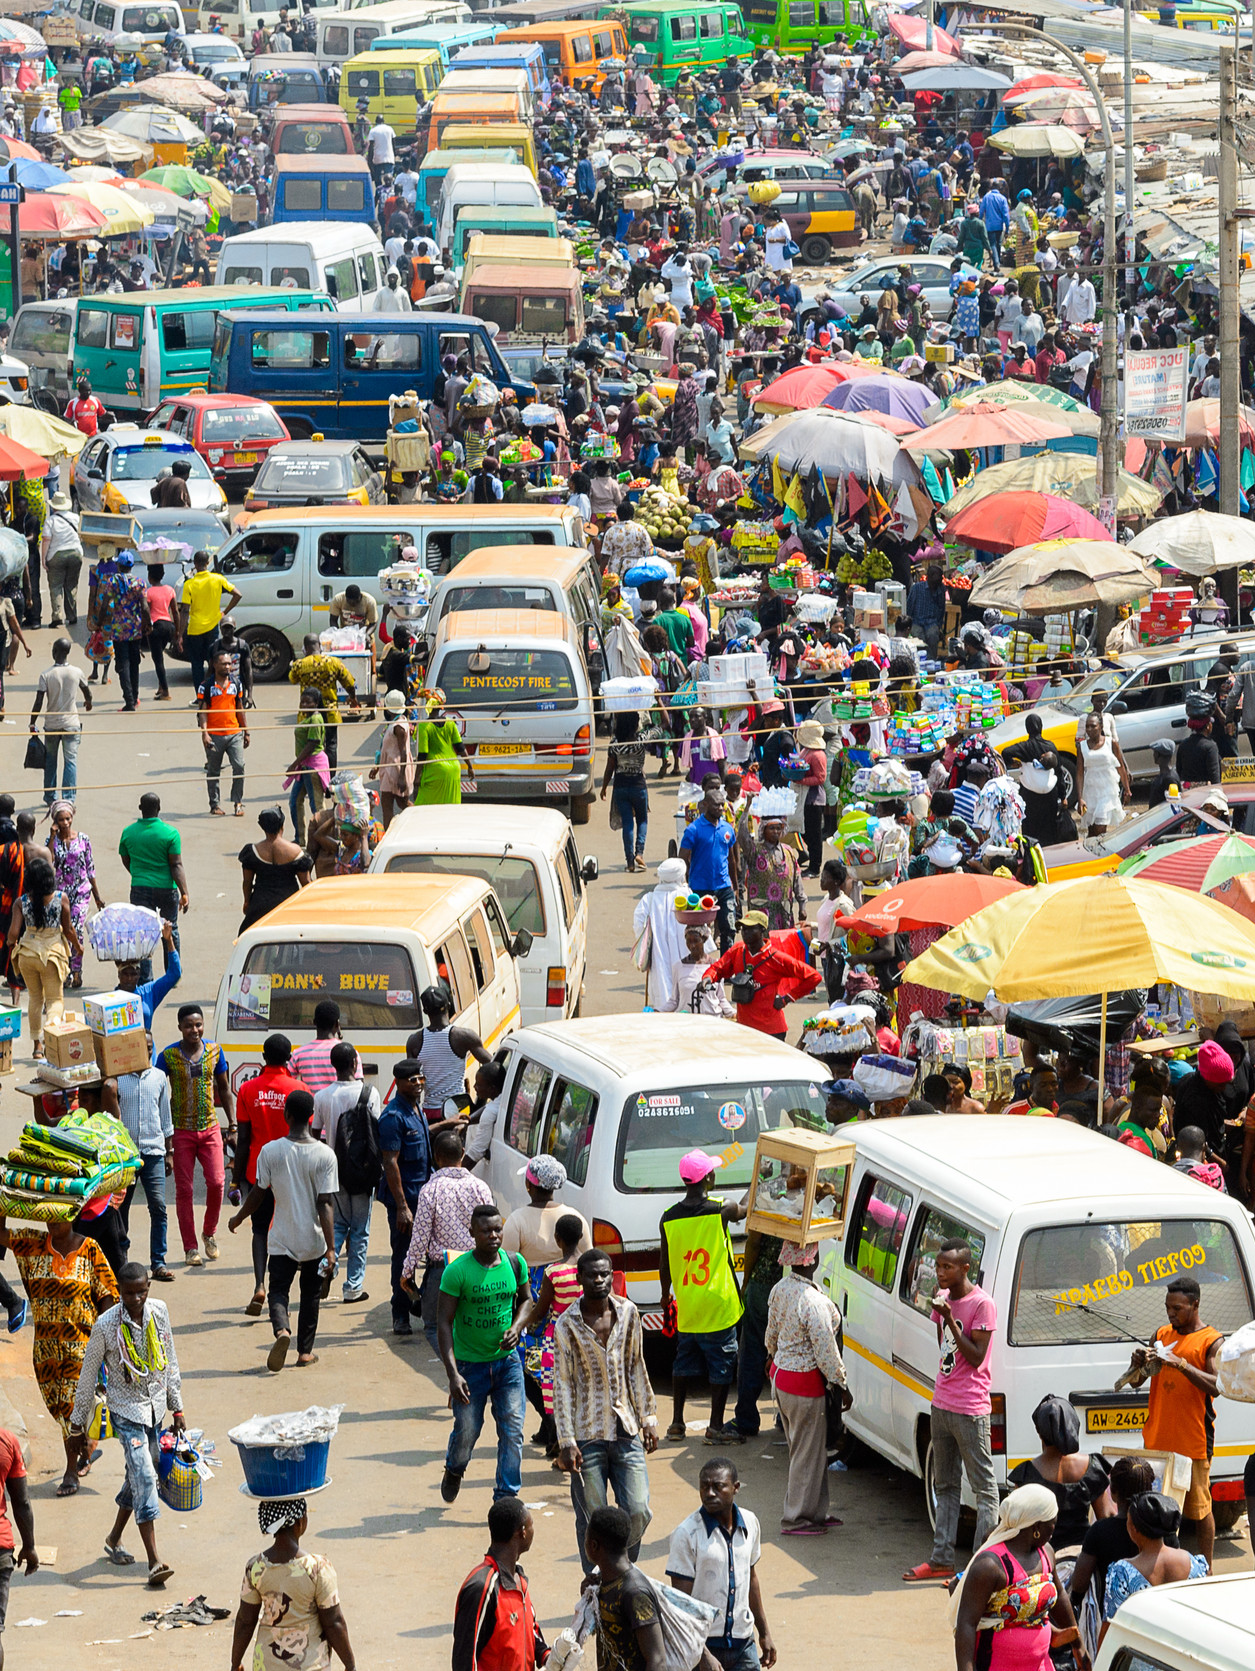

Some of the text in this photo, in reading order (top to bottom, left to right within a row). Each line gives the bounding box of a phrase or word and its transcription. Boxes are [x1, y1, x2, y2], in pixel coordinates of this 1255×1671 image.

[463, 676, 552, 688] PENTECOST FIRE
[339, 974, 390, 990] BOYE
[650, 1096, 680, 1105] FOR SALE
[682, 1247, 710, 1287] 13
[472, 1280, 508, 1293] CHACUN
[472, 1295, 490, 1304] SON
[477, 1304, 502, 1315] CHEZ
[462, 1315, 473, 1327] LE
[1092, 1411, 1149, 1427] AW 2461
